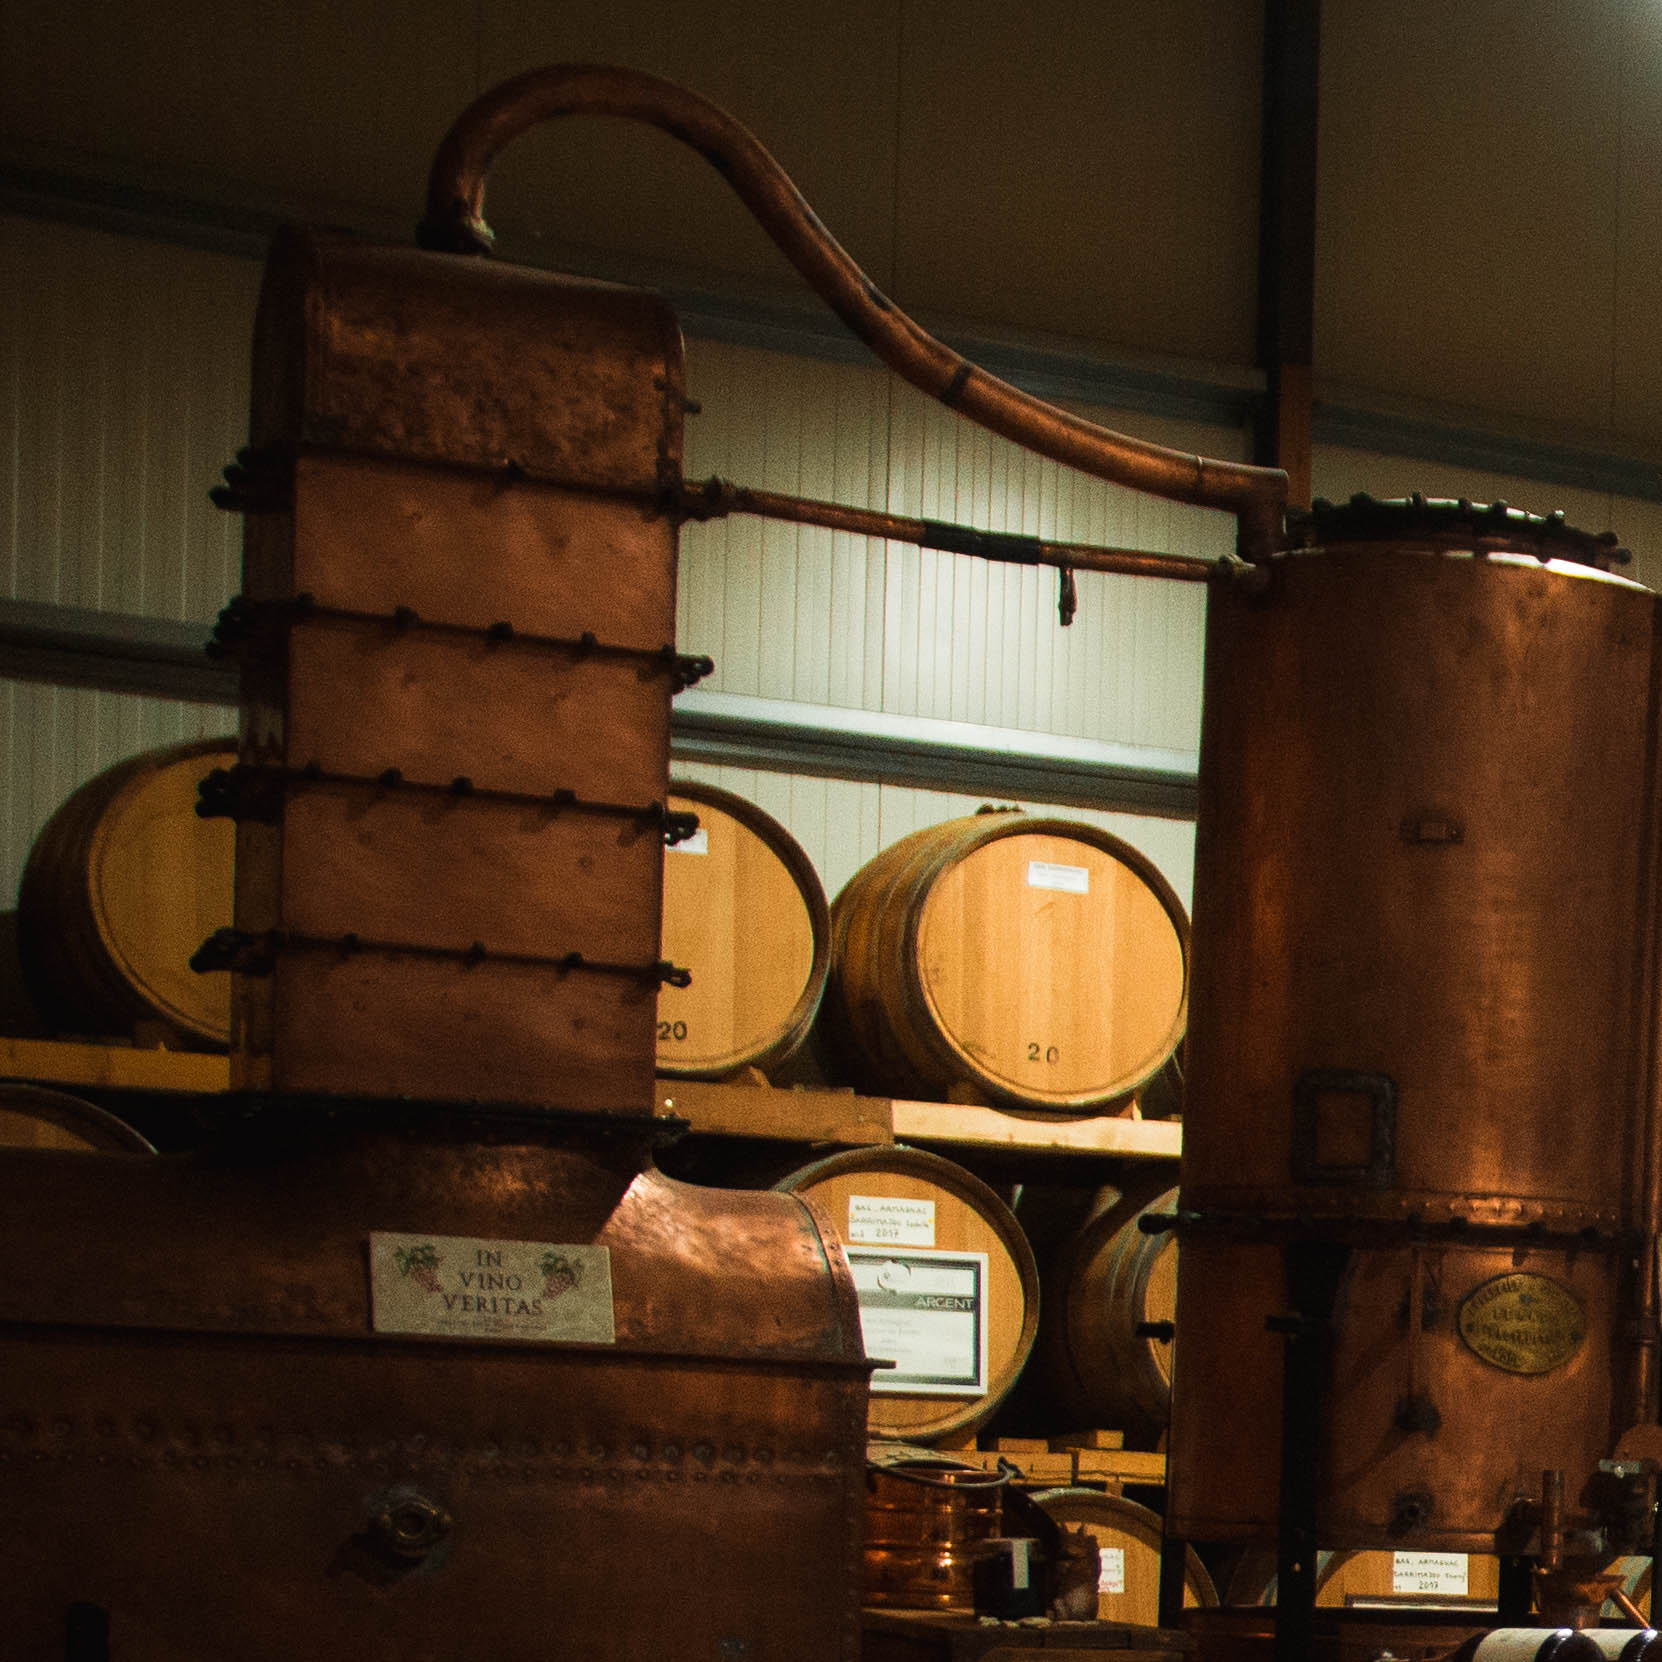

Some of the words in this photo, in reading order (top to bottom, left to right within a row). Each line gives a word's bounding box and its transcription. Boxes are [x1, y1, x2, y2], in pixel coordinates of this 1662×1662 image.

[1027, 1042, 1060, 1065] 20
[477, 1249, 502, 1267] IN
[460, 1272, 522, 1291] VINO
[443, 1294, 543, 1316] VERITAS
[914, 1296, 974, 1309] ARGENT
